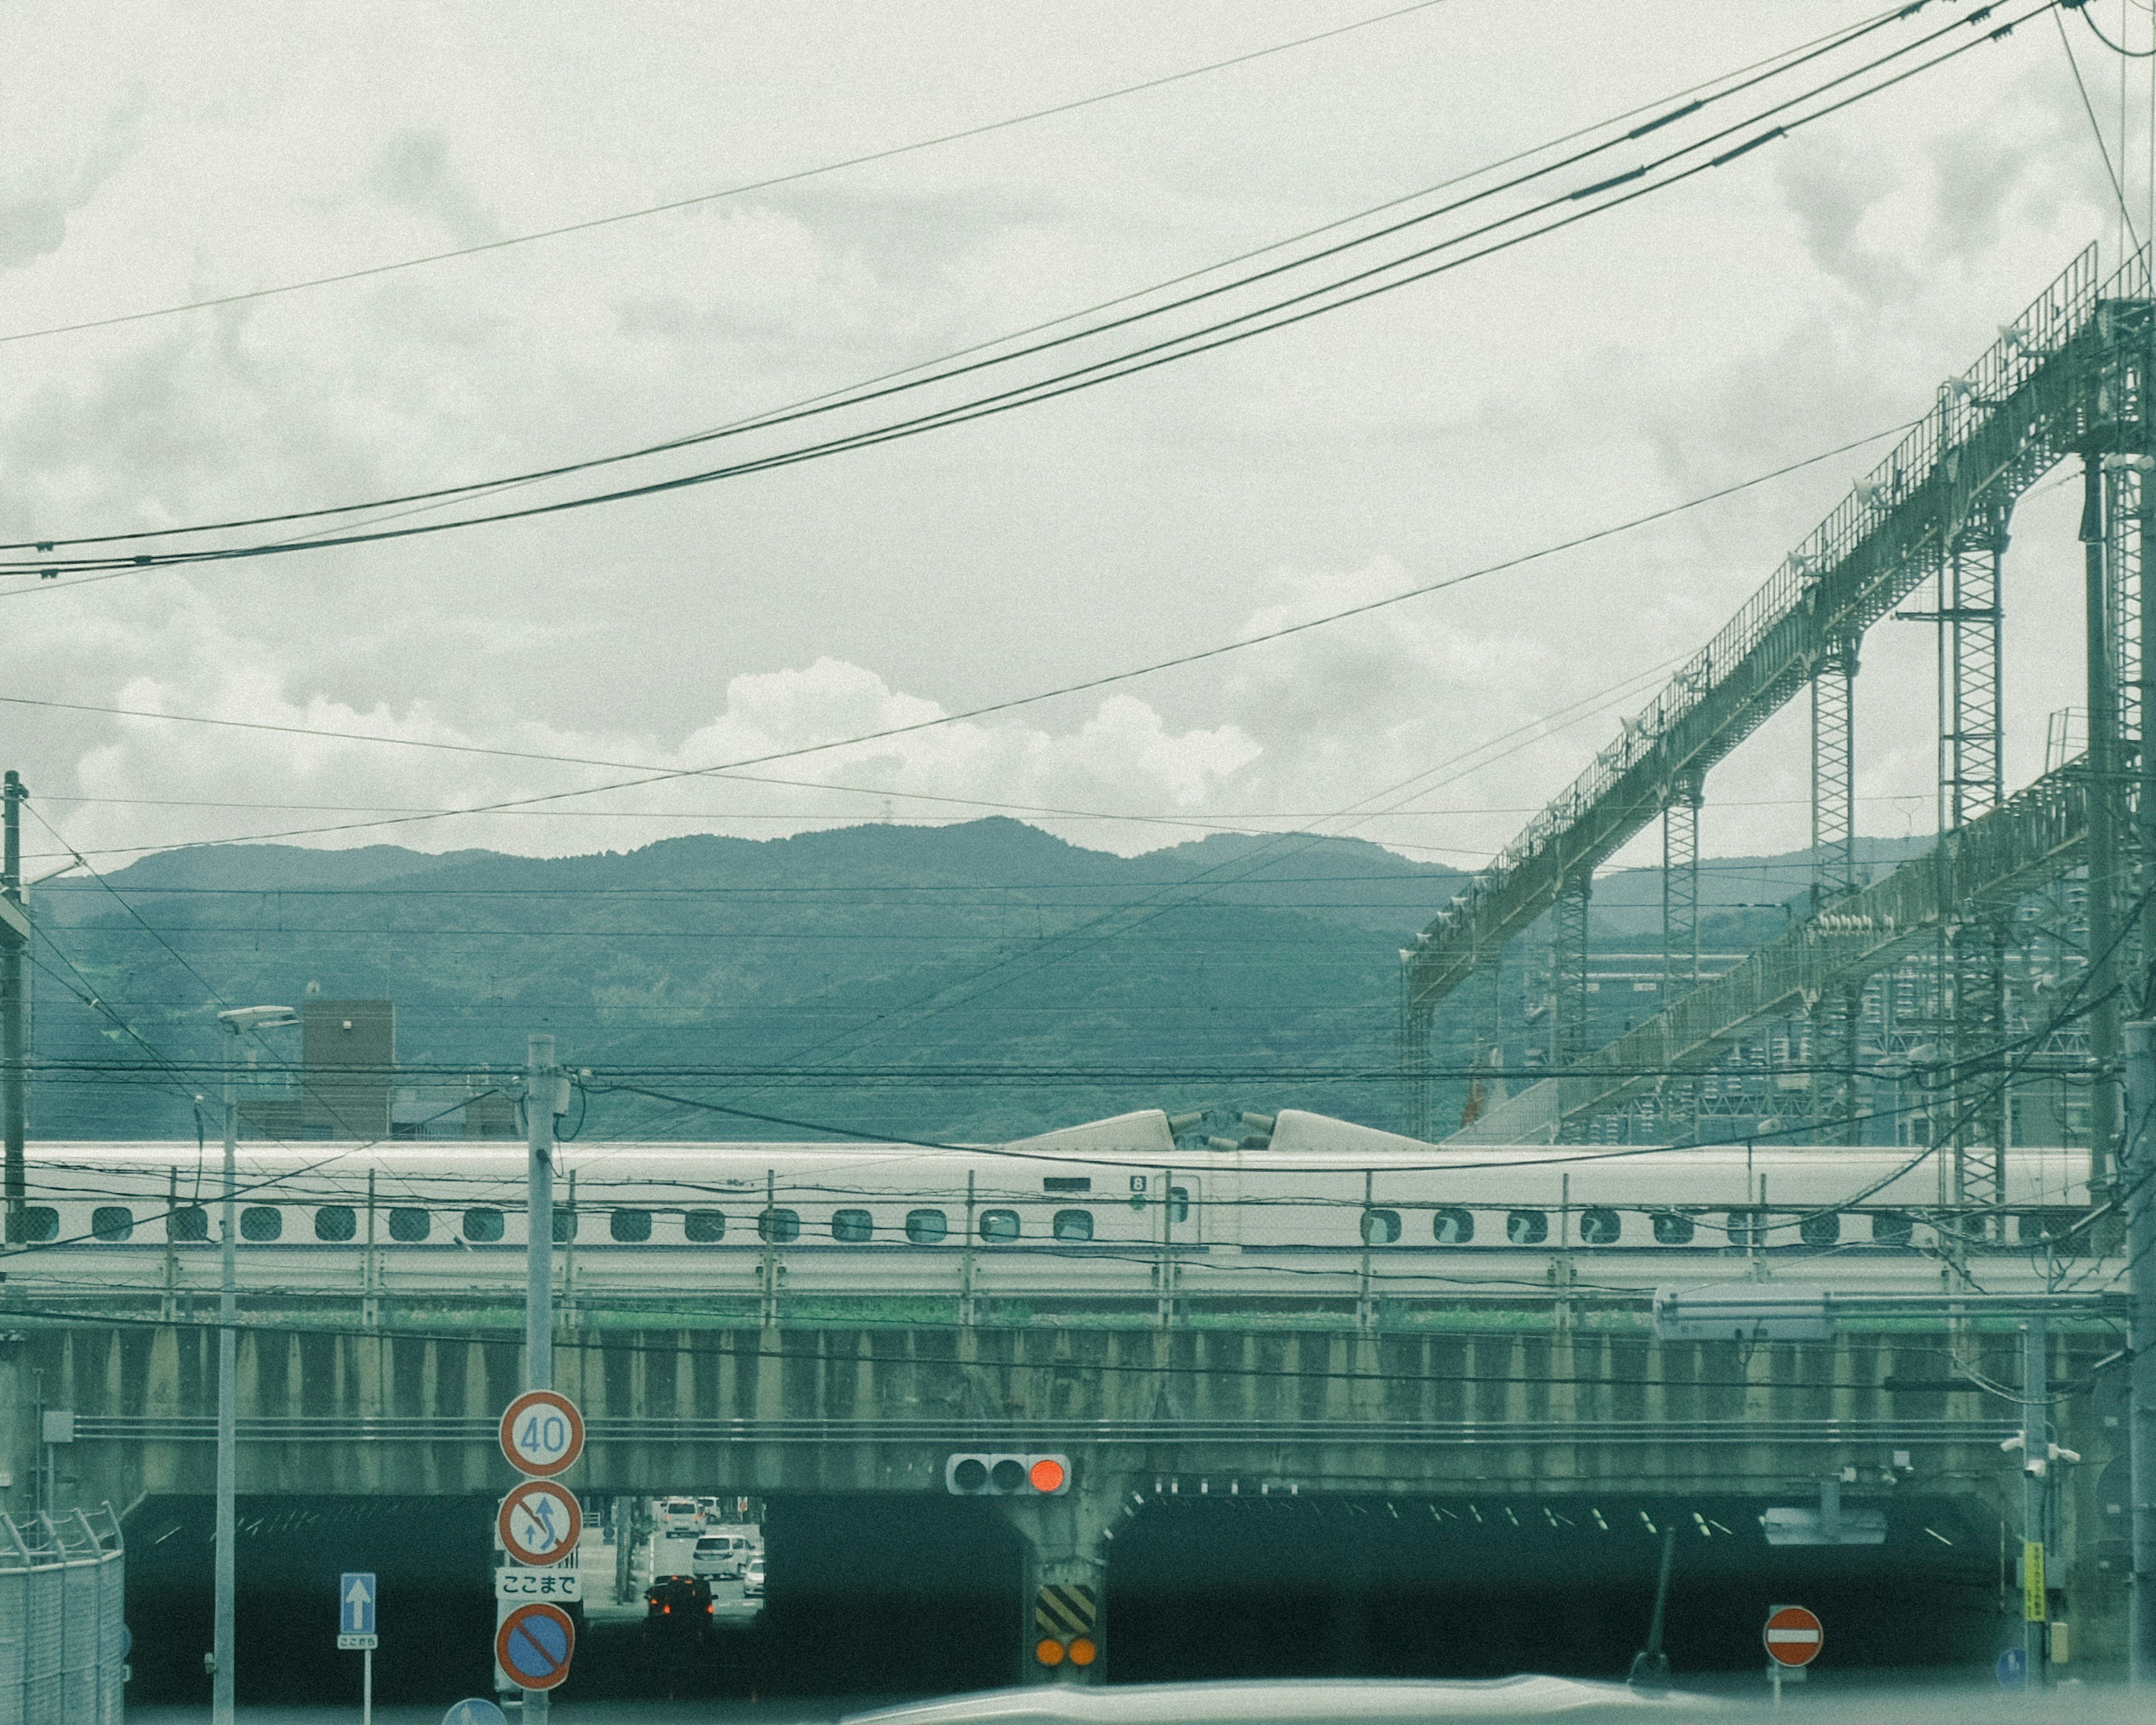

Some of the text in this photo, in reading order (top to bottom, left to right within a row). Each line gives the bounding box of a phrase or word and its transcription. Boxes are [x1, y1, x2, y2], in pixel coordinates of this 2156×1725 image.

[1134, 1178, 1143, 1190] 8
[520, 1417, 564, 1452] 40
[504, 1576, 575, 1594] ここまで
